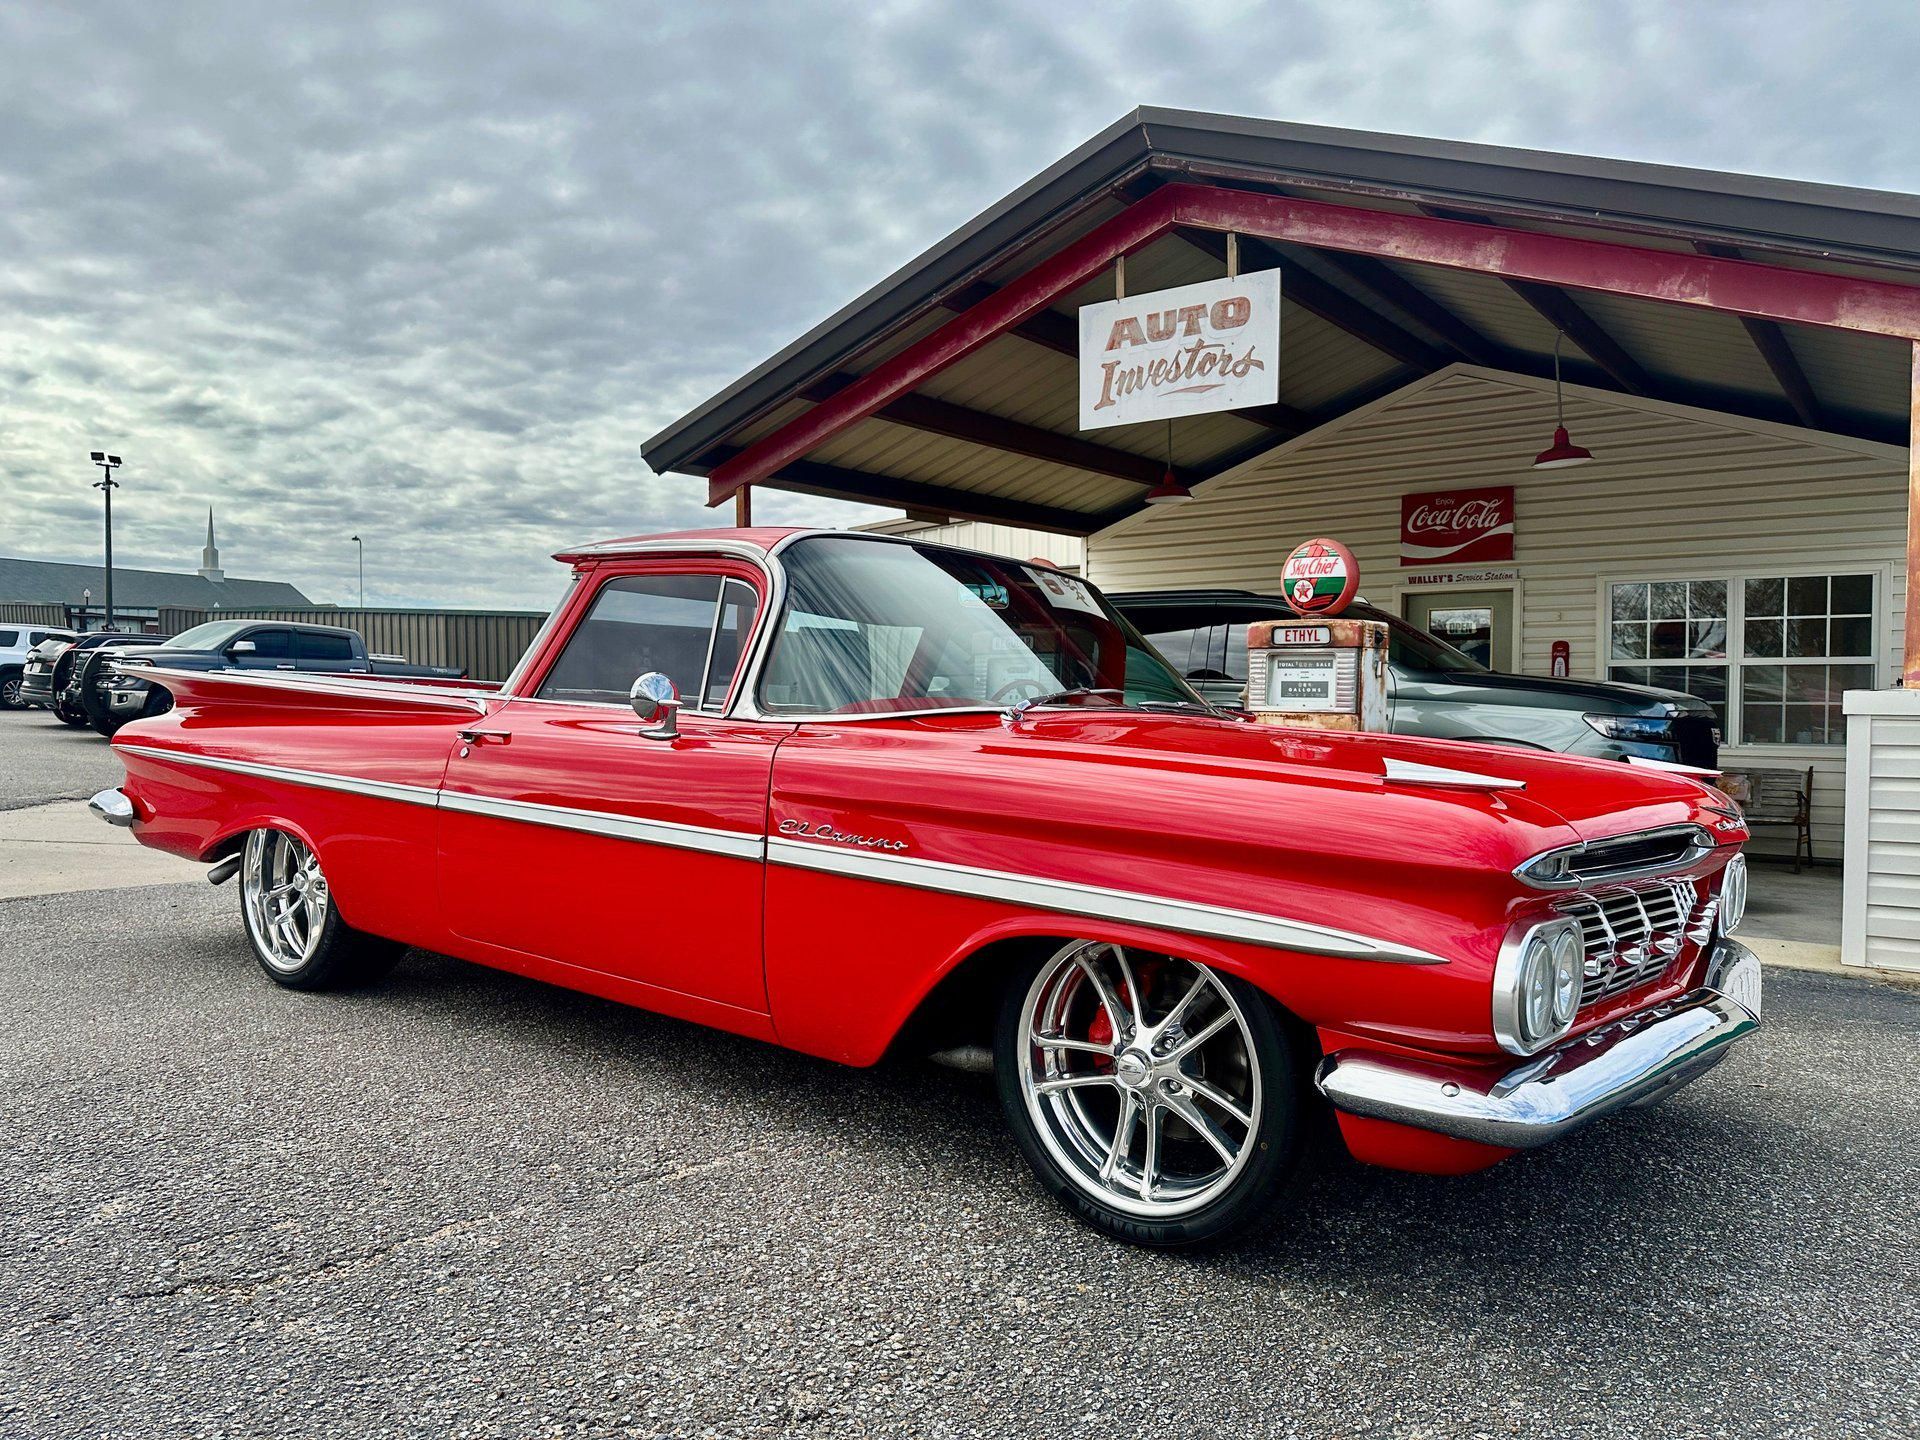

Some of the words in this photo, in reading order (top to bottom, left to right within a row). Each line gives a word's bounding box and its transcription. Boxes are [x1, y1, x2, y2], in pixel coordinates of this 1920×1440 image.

[1105, 296, 1252, 352] AUTO
[1093, 338, 1265, 411] Investors
[1435, 498, 1456, 506] Enjoy
[1407, 499, 1504, 533] Coca-Cola
[1290, 558, 1309, 577] Sky
[1308, 557, 1339, 575] Chief
[1408, 574, 1454, 584] WALLEY'S
[1455, 573, 1483, 582] Service
[1484, 572, 1513, 581] Station
[1284, 629, 1321, 642] ETHYL
[1449, 622, 1473, 633] OPEN
[815, 824, 909, 850] Camino
